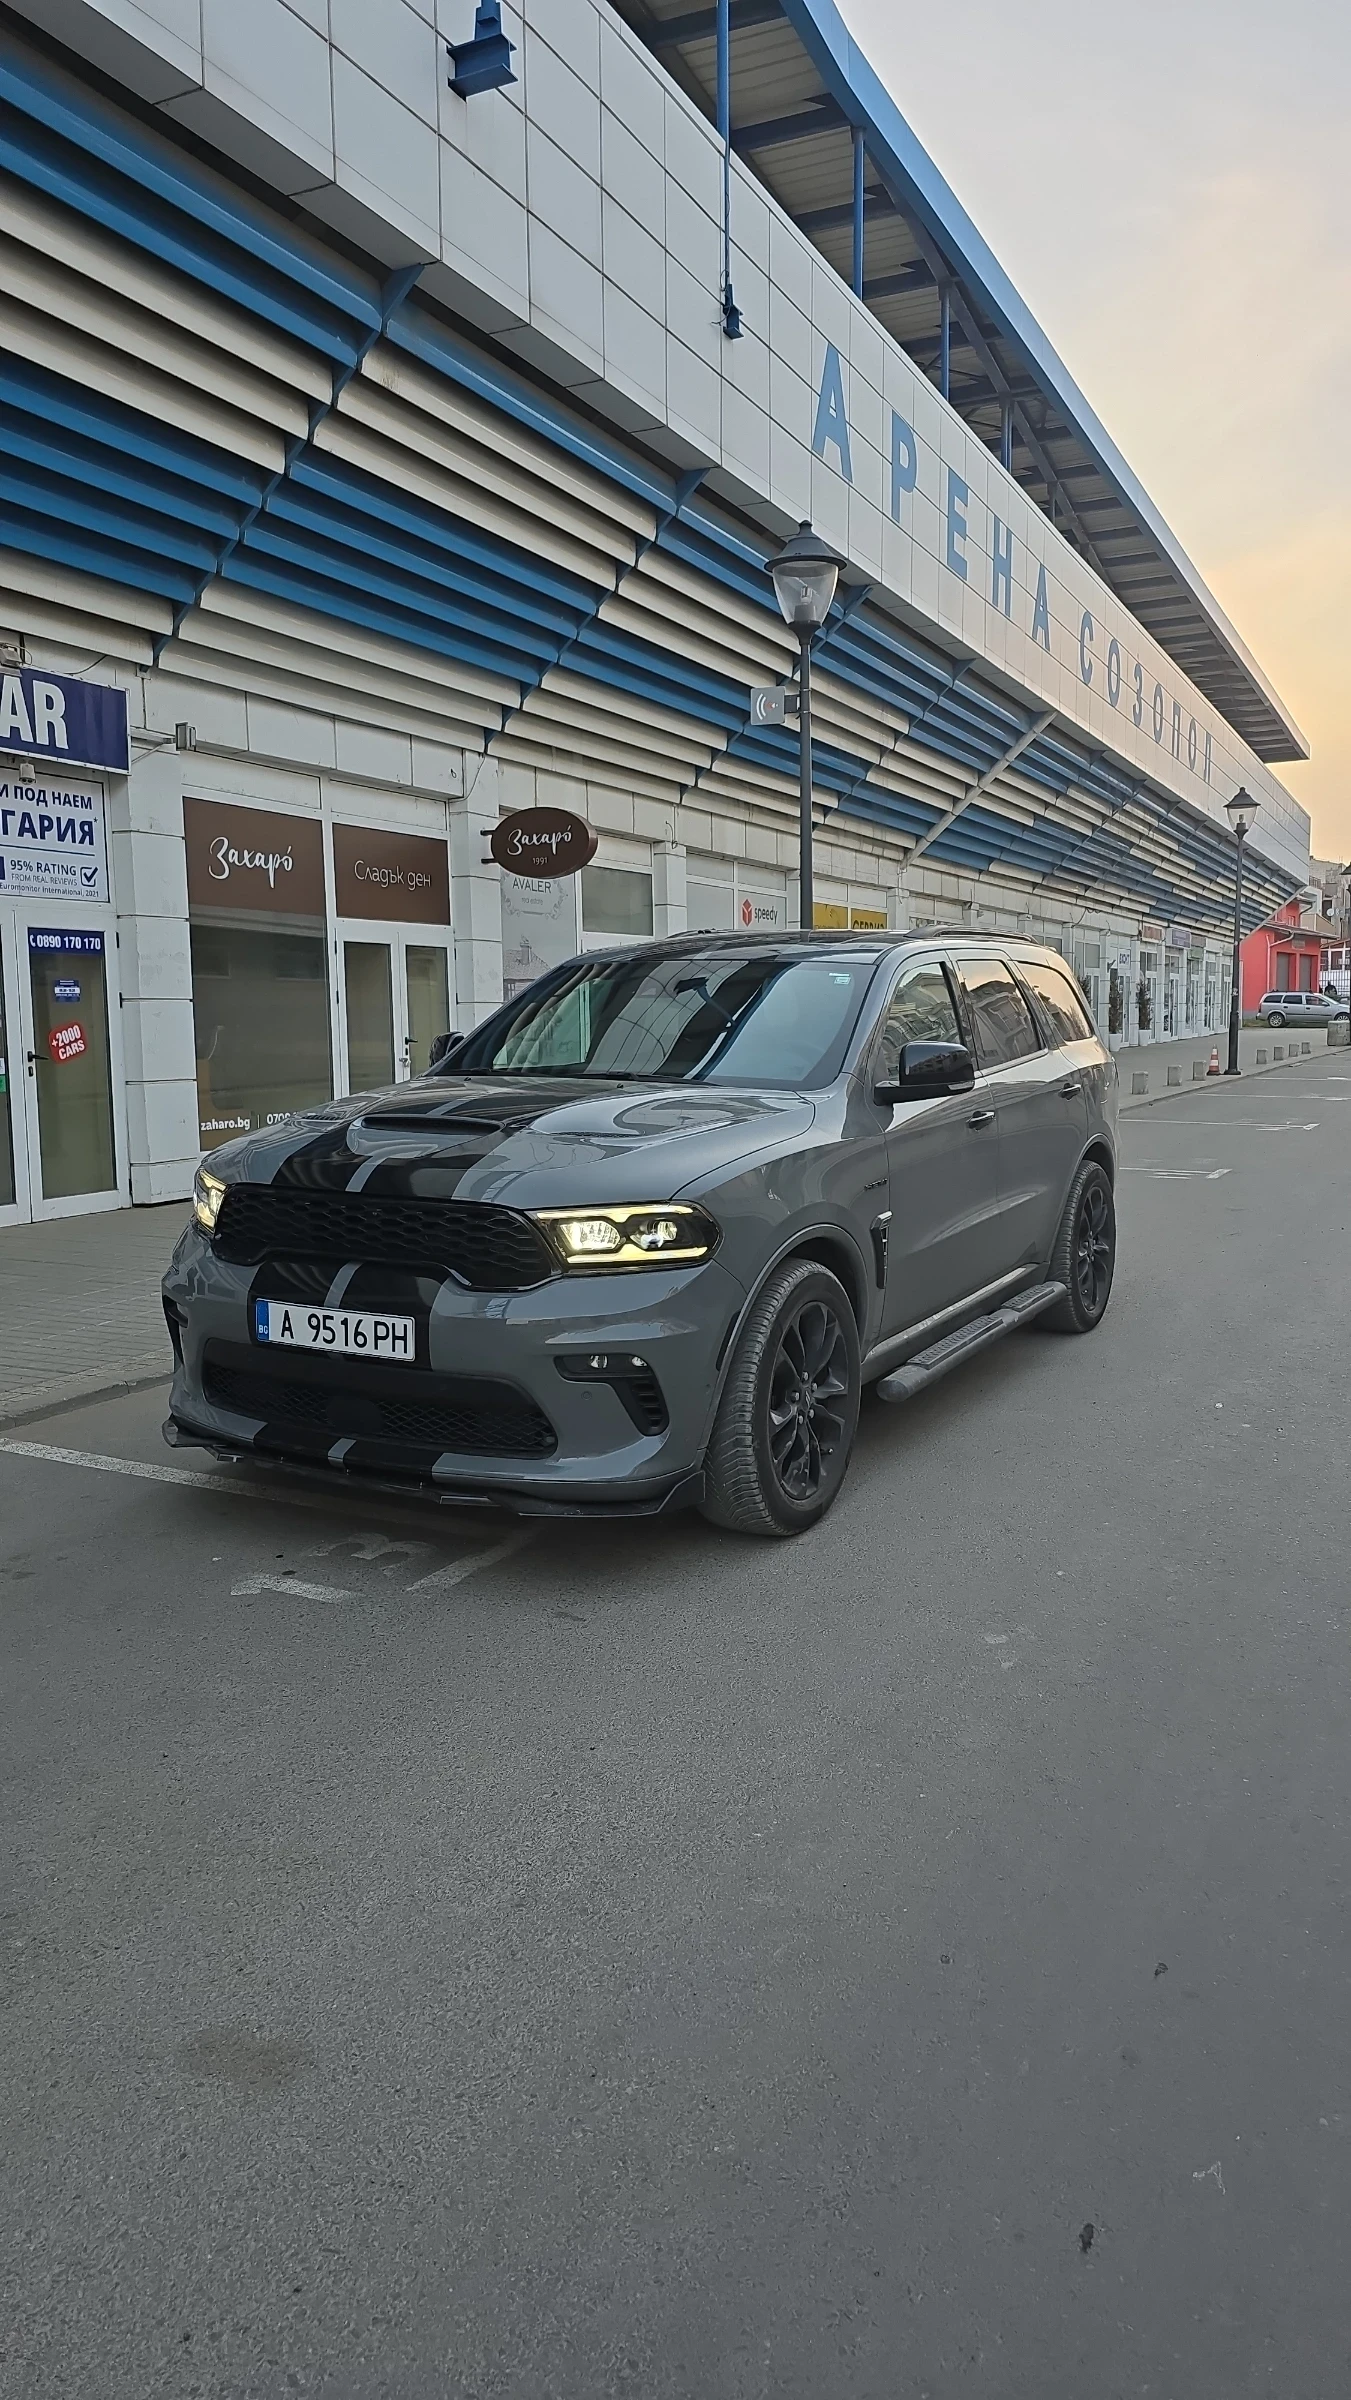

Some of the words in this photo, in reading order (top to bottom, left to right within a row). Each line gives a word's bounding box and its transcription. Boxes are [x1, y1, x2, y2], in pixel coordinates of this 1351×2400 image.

[14, 785, 49, 808] ПОД
[51, 791, 93, 810] НАЕМ
[10, 860, 33, 872] 95%
[36, 862, 77, 876] RATING
[532, 857, 548, 866] 1991
[11, 873, 32, 882] FROM
[32, 875, 49, 884] REAL
[50, 877, 78, 887] REVIEWS
[354, 860, 405, 888] Сладък
[407, 872, 431, 891] ден
[85, 890, 99, 898] 2021
[512, 877, 552, 894] AVALER
[754, 905, 778, 925] speedy
[37, 934, 61, 948] 0890
[64, 936, 81, 949] 170
[83, 937, 101, 950] 170
[52, 1024, 81, 1048] +2000
[58, 1040, 85, 1060] CARS
[200, 1116, 251, 1131] zaharo.bg
[258, 1324, 269, 1335] BG
[307, 1312, 368, 1349] 9516
